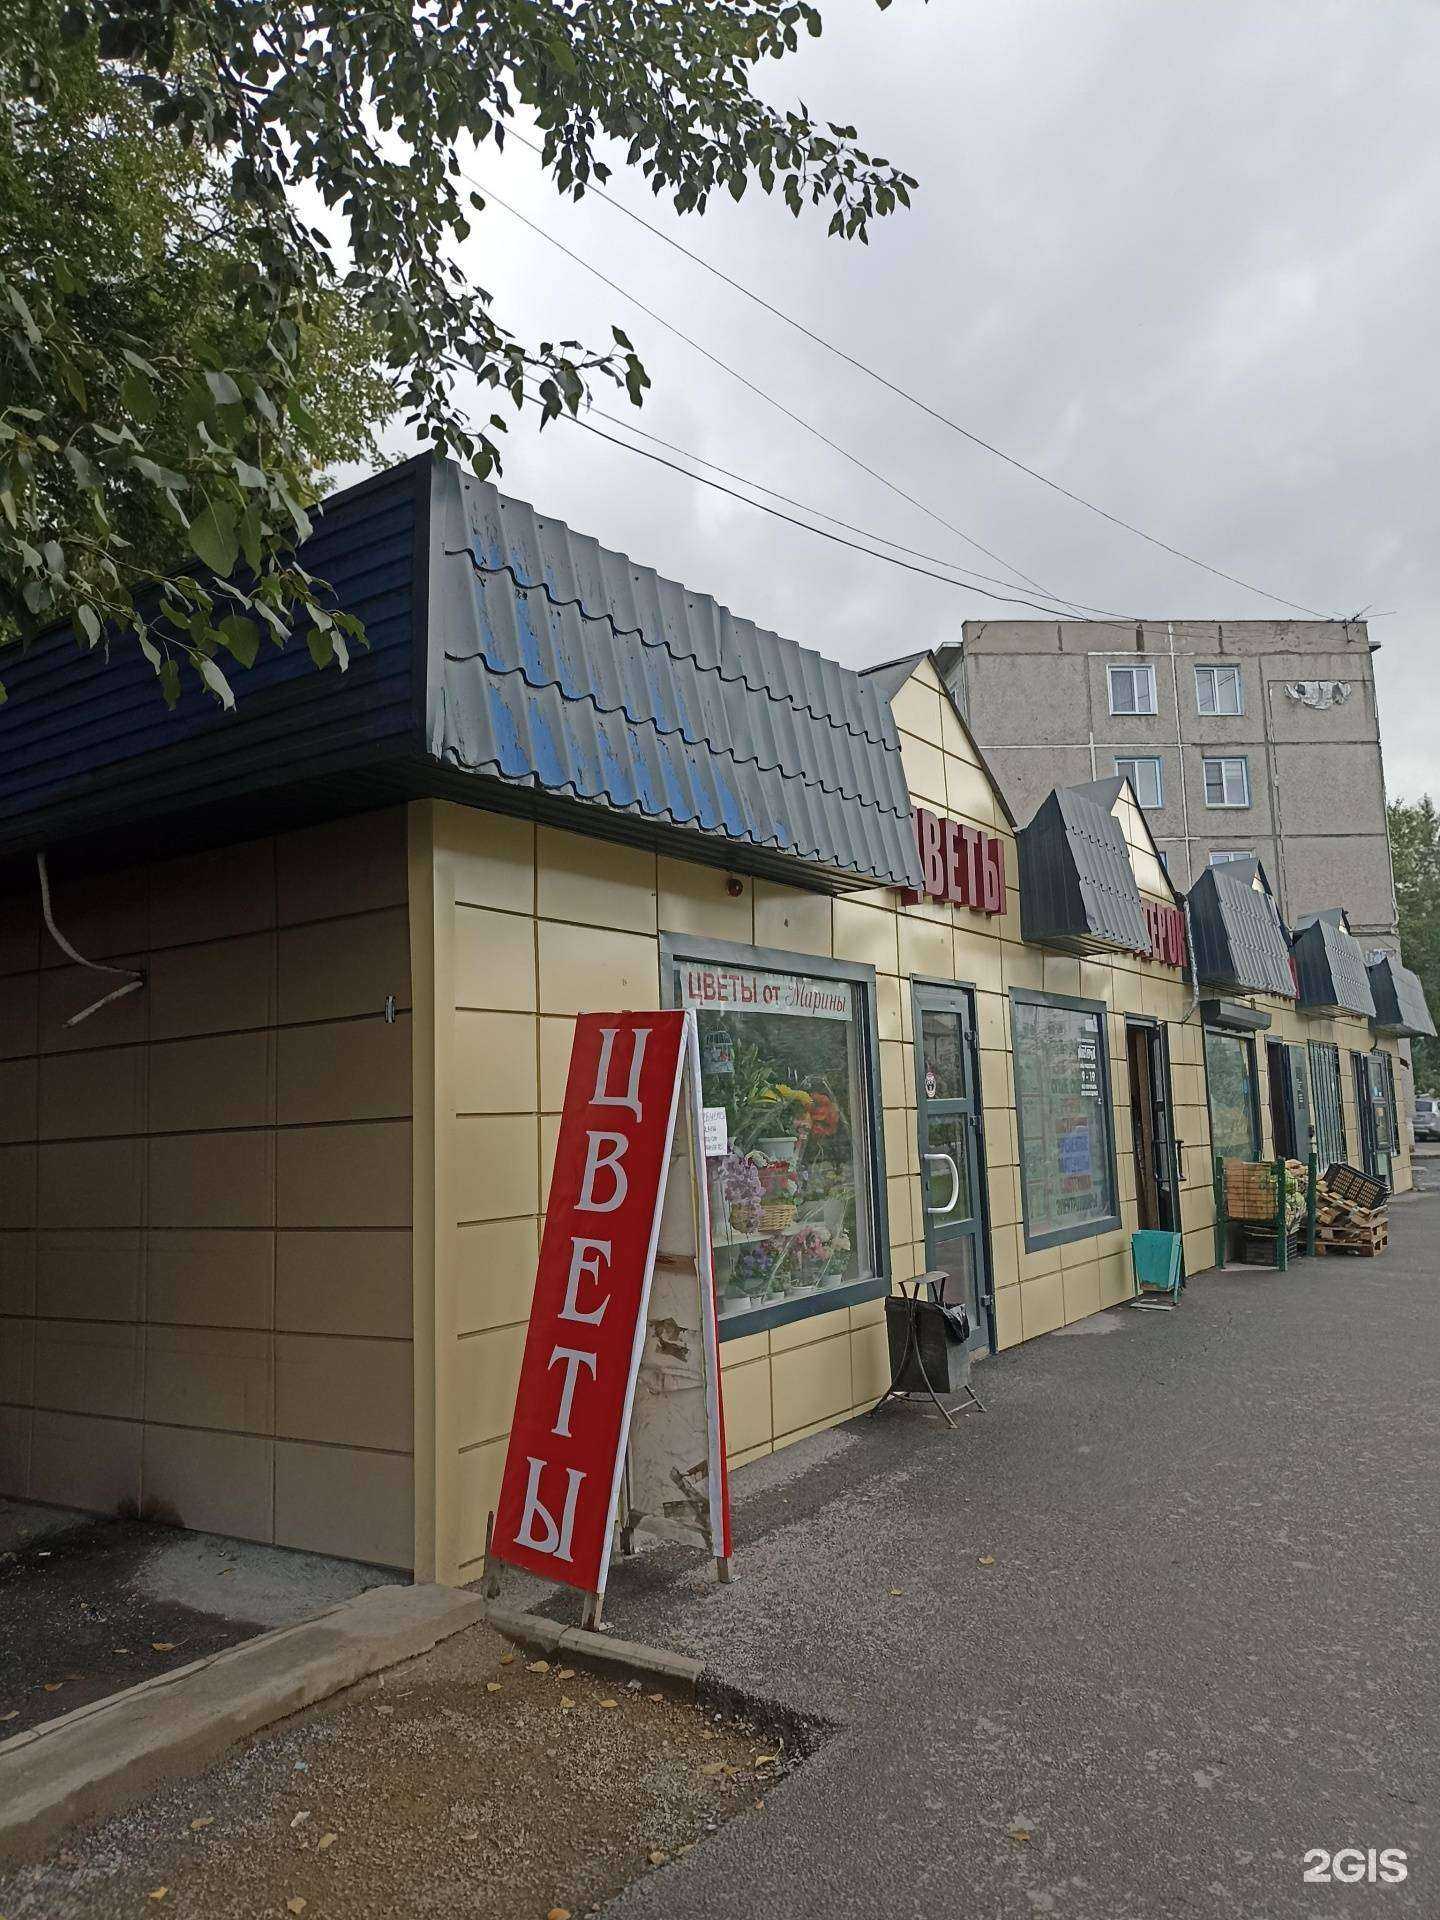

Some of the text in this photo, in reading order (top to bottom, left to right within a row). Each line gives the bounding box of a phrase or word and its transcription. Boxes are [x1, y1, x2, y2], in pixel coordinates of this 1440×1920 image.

[687, 971, 846, 1014] ЦВЕТЫ от Марины
[512, 1027, 653, 1563] ЦВЕТЫ
